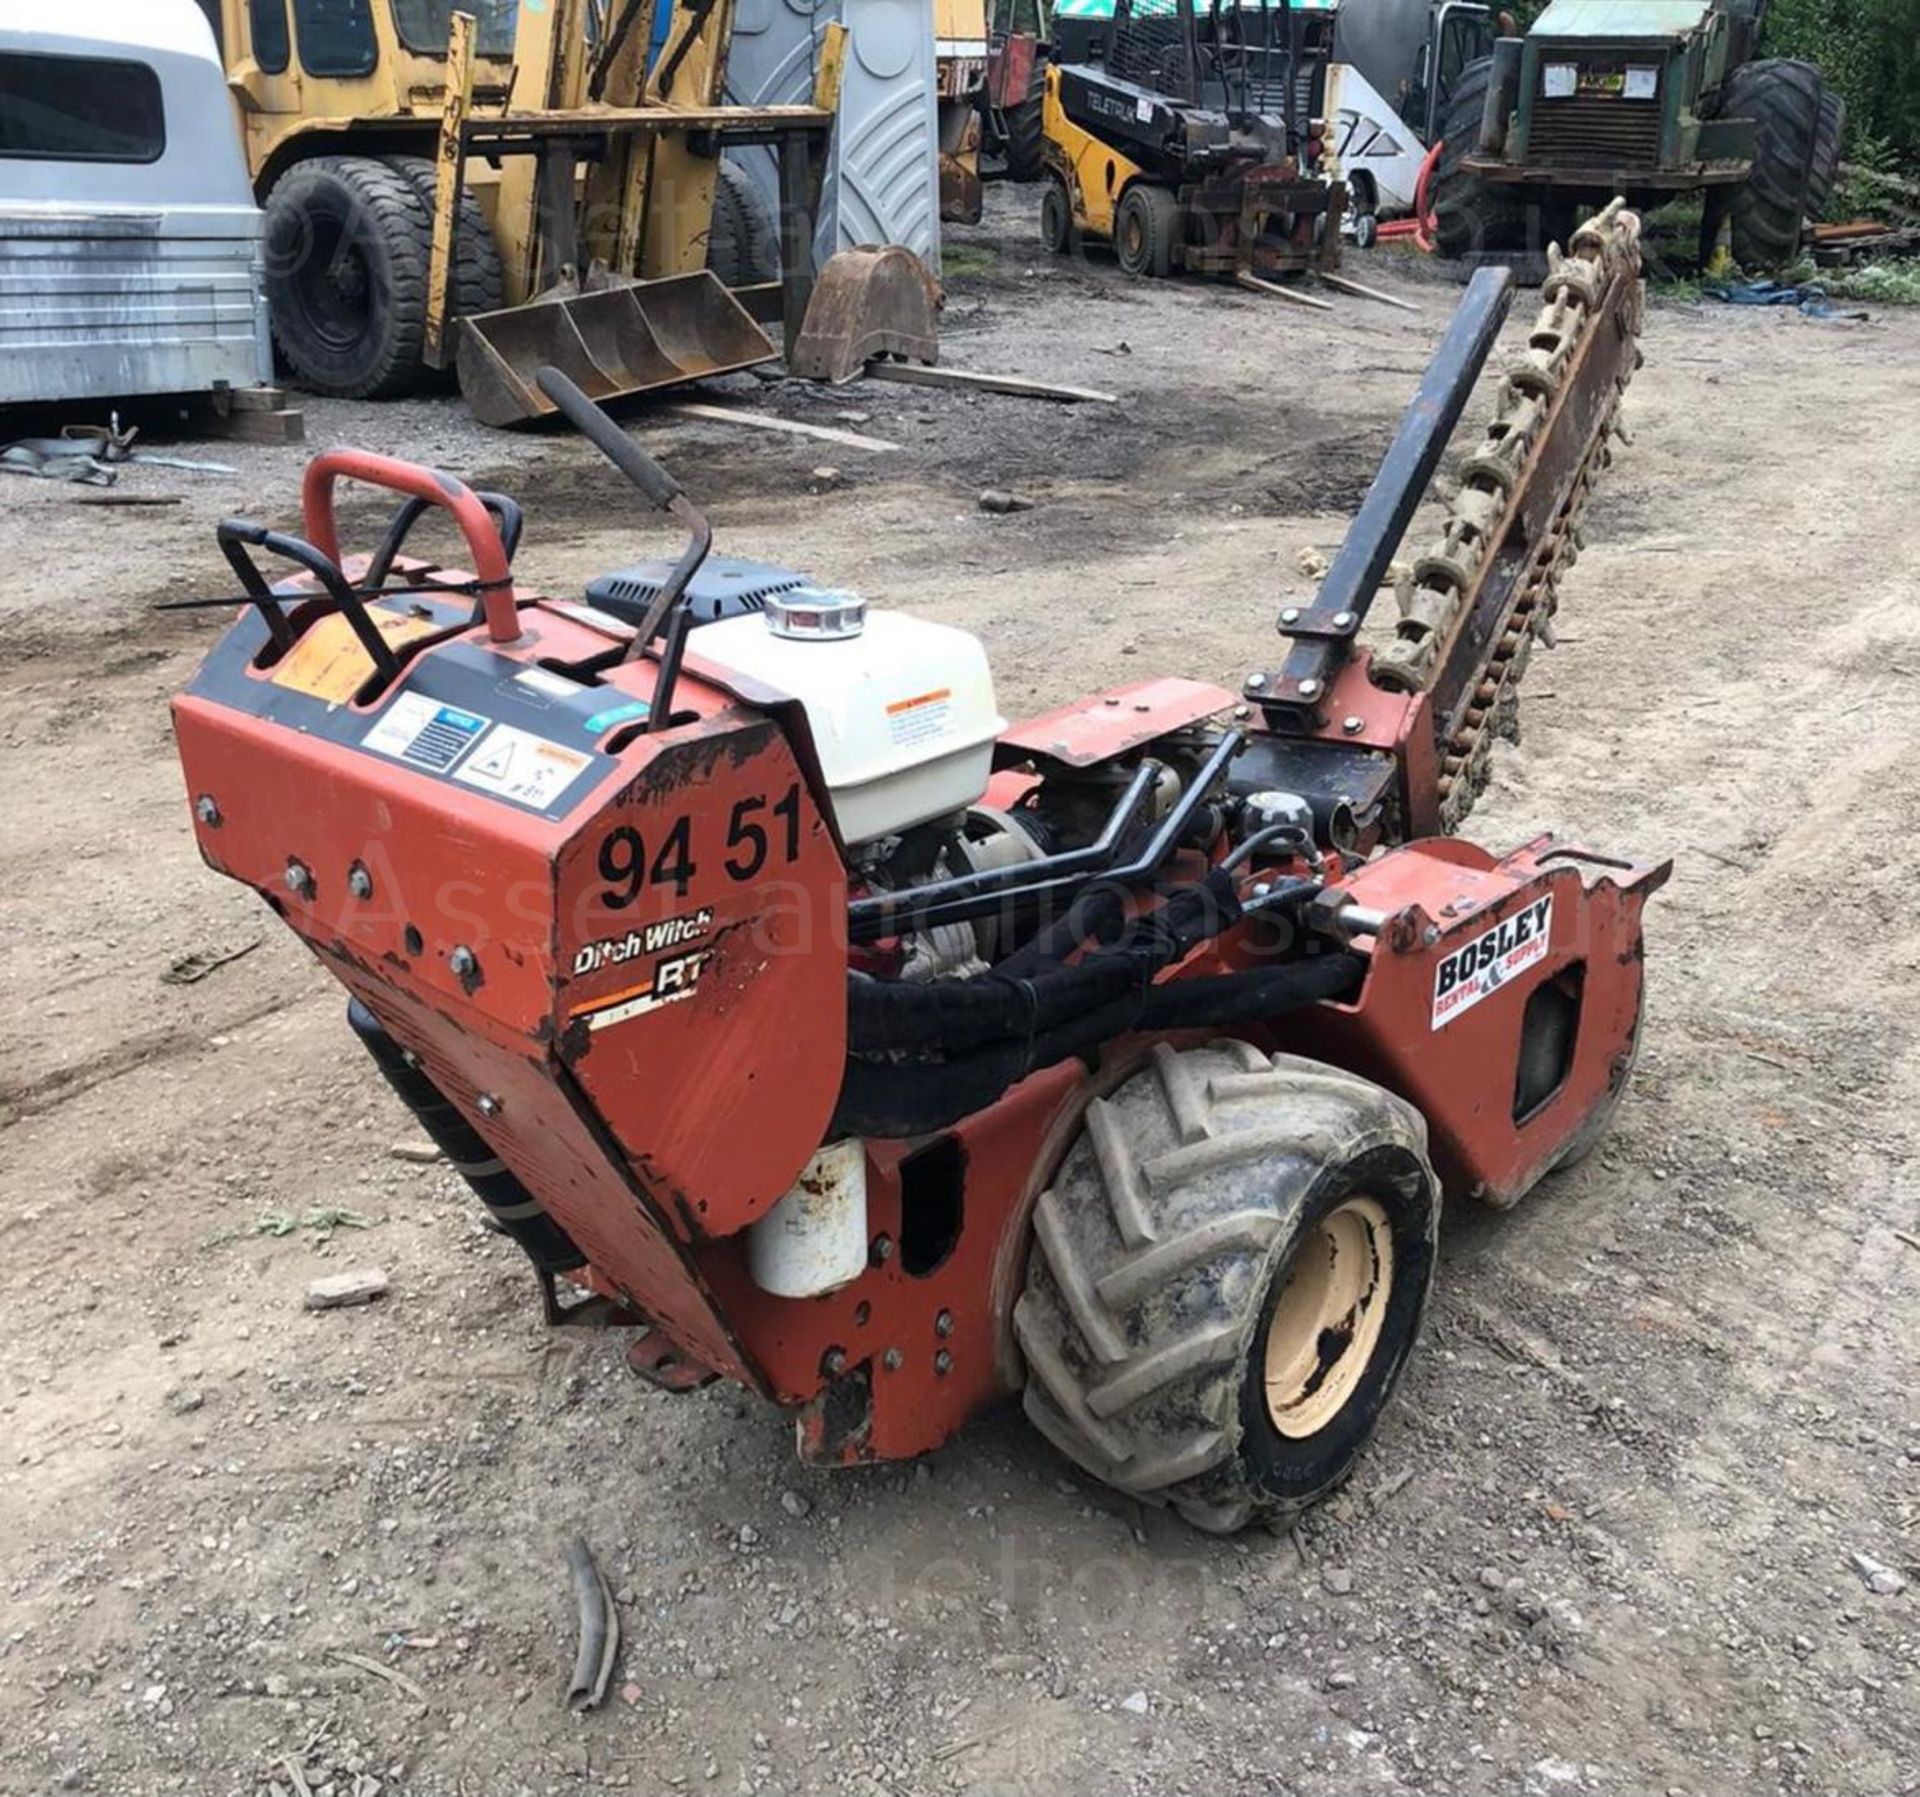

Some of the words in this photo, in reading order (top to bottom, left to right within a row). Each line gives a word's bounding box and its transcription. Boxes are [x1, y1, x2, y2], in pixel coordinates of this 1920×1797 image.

[598, 814, 697, 910] 94
[724, 782, 800, 881] 51
[573, 931, 642, 975] Ditch
[645, 908, 713, 951] Witch
[656, 952, 710, 994] RT
[1437, 896, 1551, 998] BOSLEY
